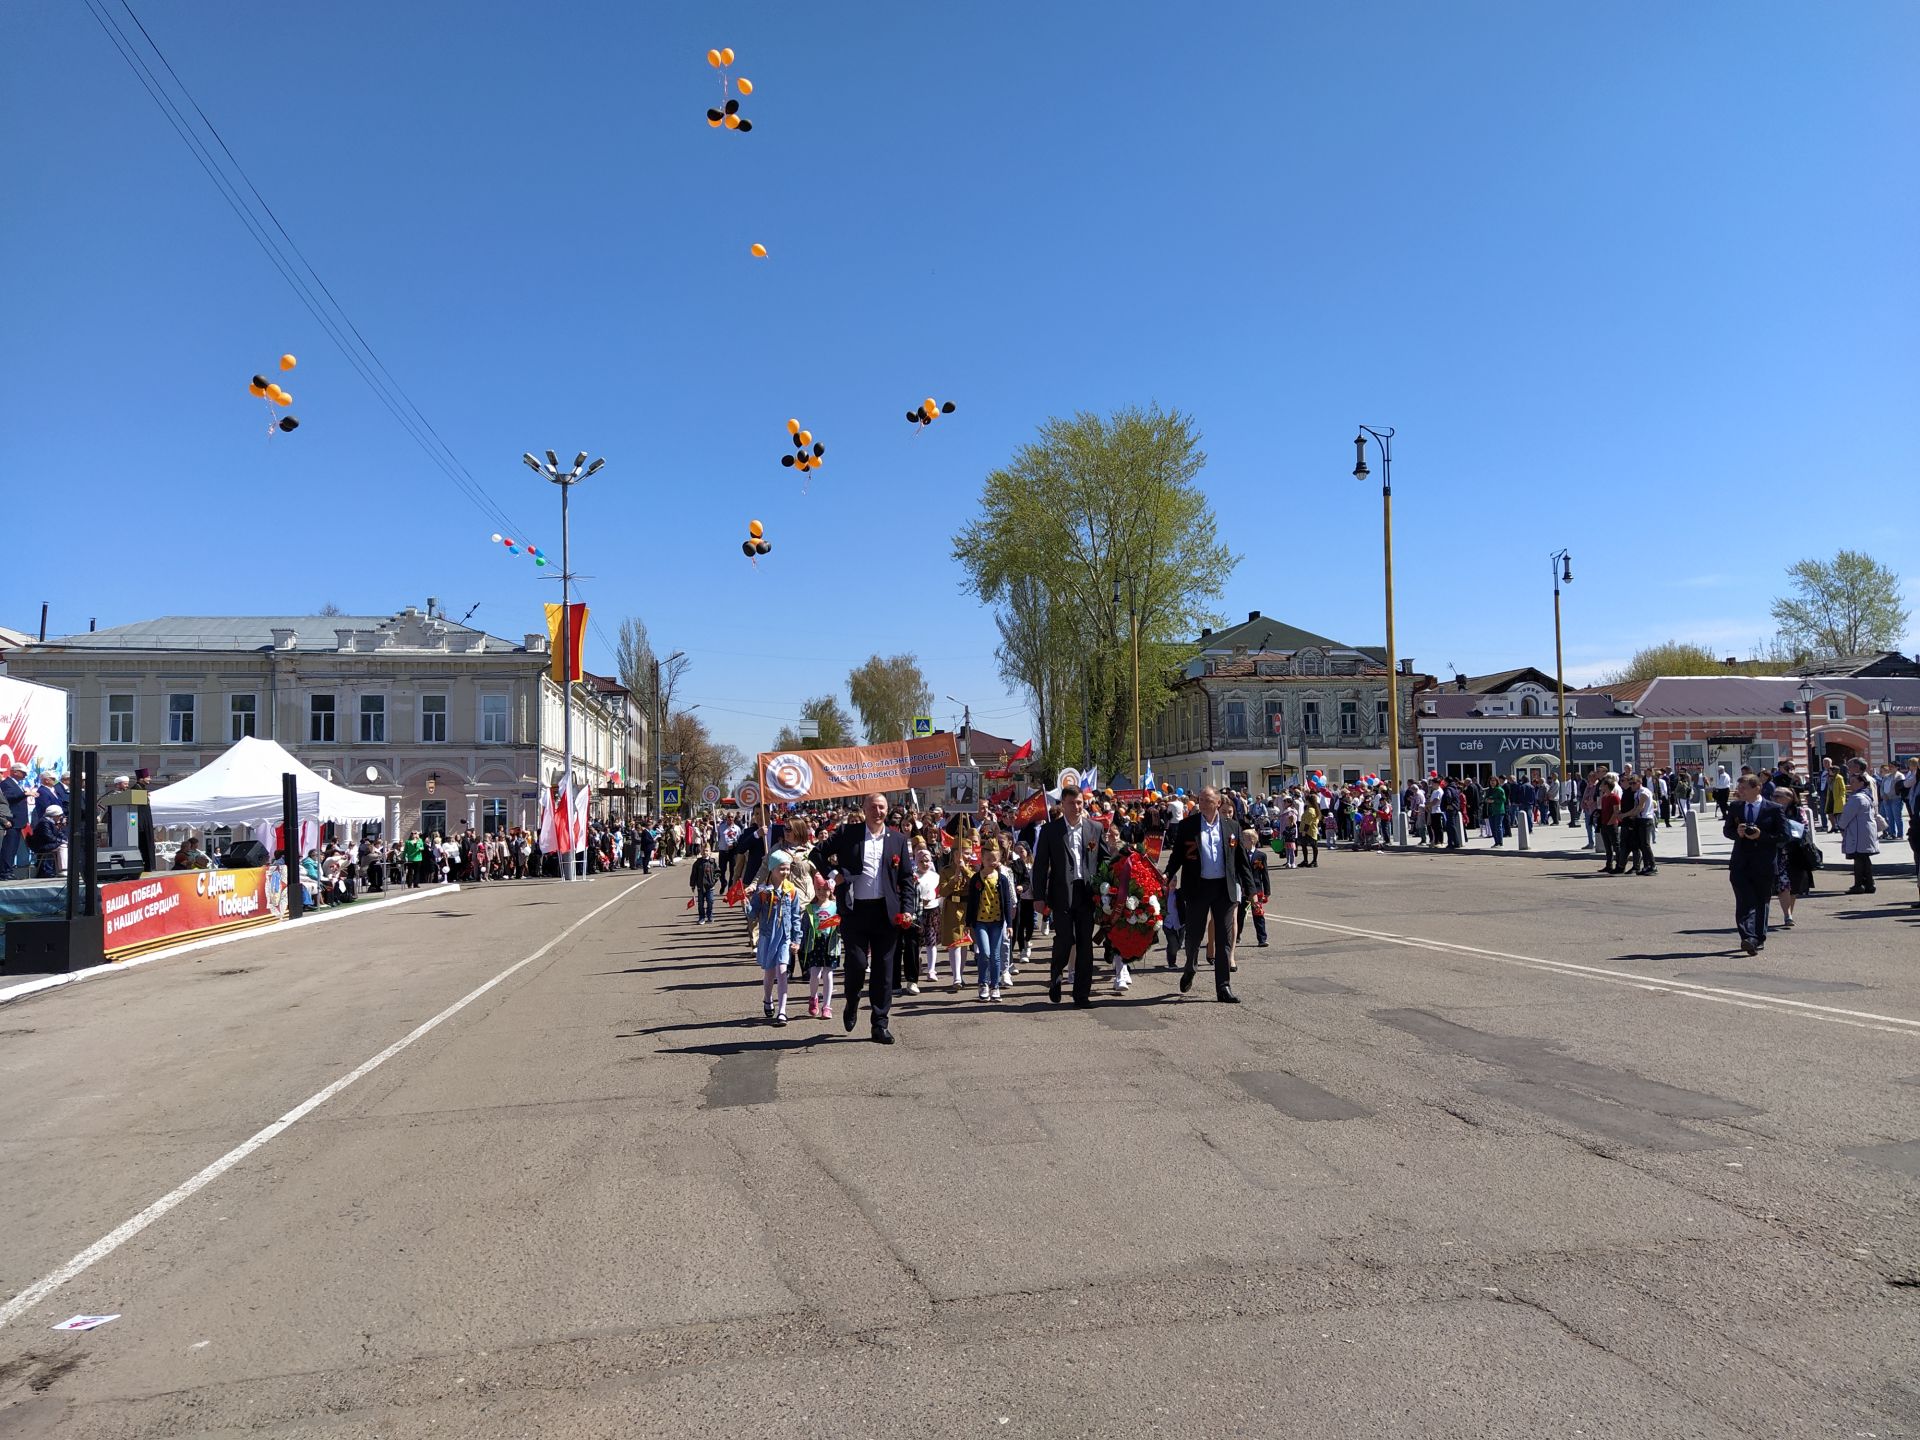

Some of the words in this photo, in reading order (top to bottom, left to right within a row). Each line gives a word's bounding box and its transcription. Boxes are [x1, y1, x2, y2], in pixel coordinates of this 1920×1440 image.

[1460, 739, 1483, 751] café
[1575, 740, 1604, 752] кафе
[823, 763, 859, 772] ФИЛИАЛ
[875, 750, 950, 767] «ТАТЭНЕРГОСБЫТ»
[828, 769, 899, 783] ЧИСТОПОЛЬСКОЕ
[197, 873, 205, 895] С
[207, 872, 235, 896] Днем
[105, 893, 130, 914] ВАША
[131, 882, 162, 904] ПОБЕДА
[218, 890, 259, 917] Победы!
[106, 921, 113, 935] В
[114, 909, 144, 931] НАШИХ
[144, 893, 180, 919] СЕРДЦАХ!
